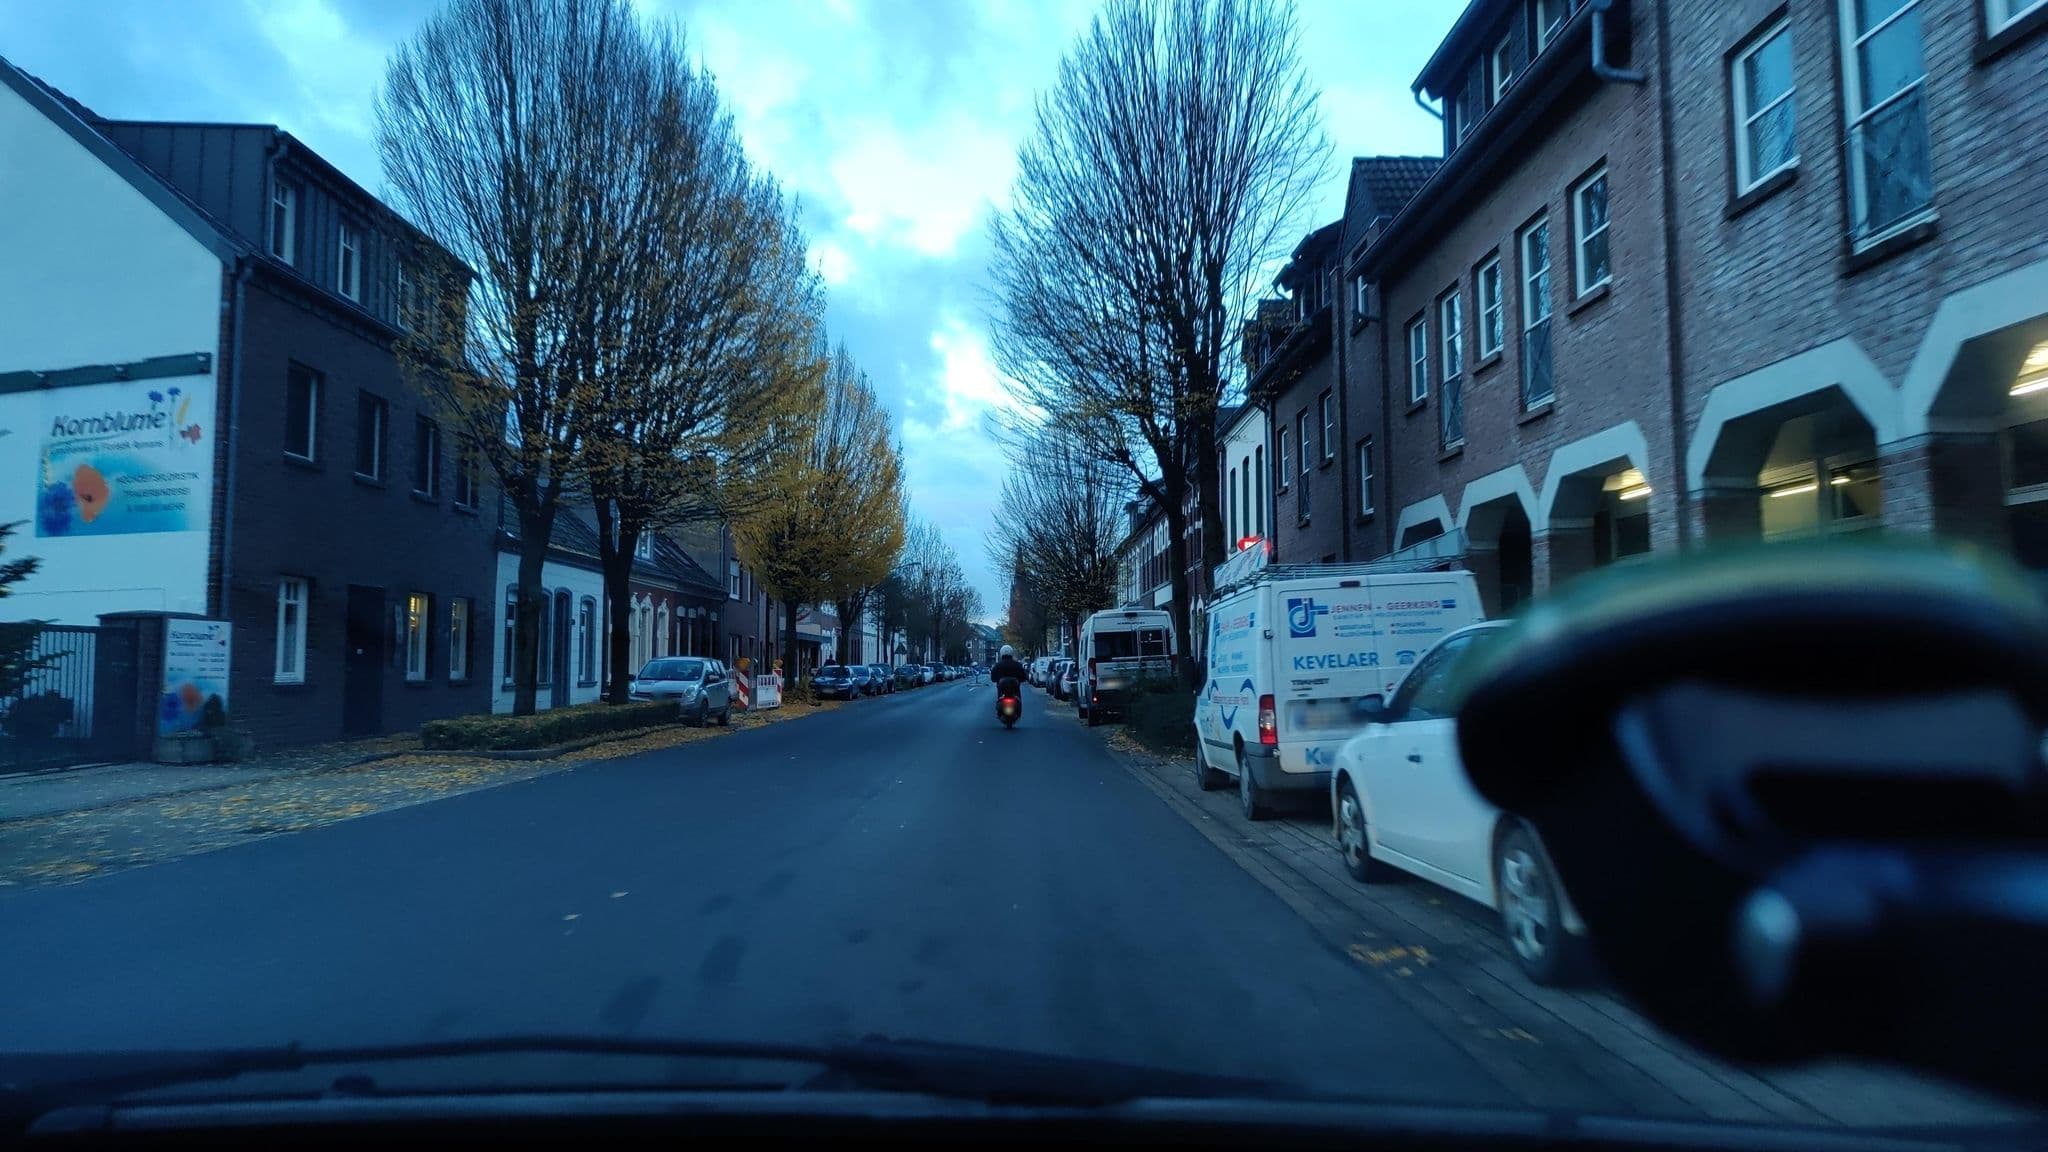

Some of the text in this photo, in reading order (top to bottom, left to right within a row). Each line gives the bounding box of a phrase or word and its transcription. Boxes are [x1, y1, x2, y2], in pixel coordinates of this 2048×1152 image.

[51, 411, 166, 437] Kornblume
[1331, 602, 1372, 614] JENNEN
[1387, 600, 1440, 610] GEERKENS
[1294, 652, 1380, 670] KEVELAER
